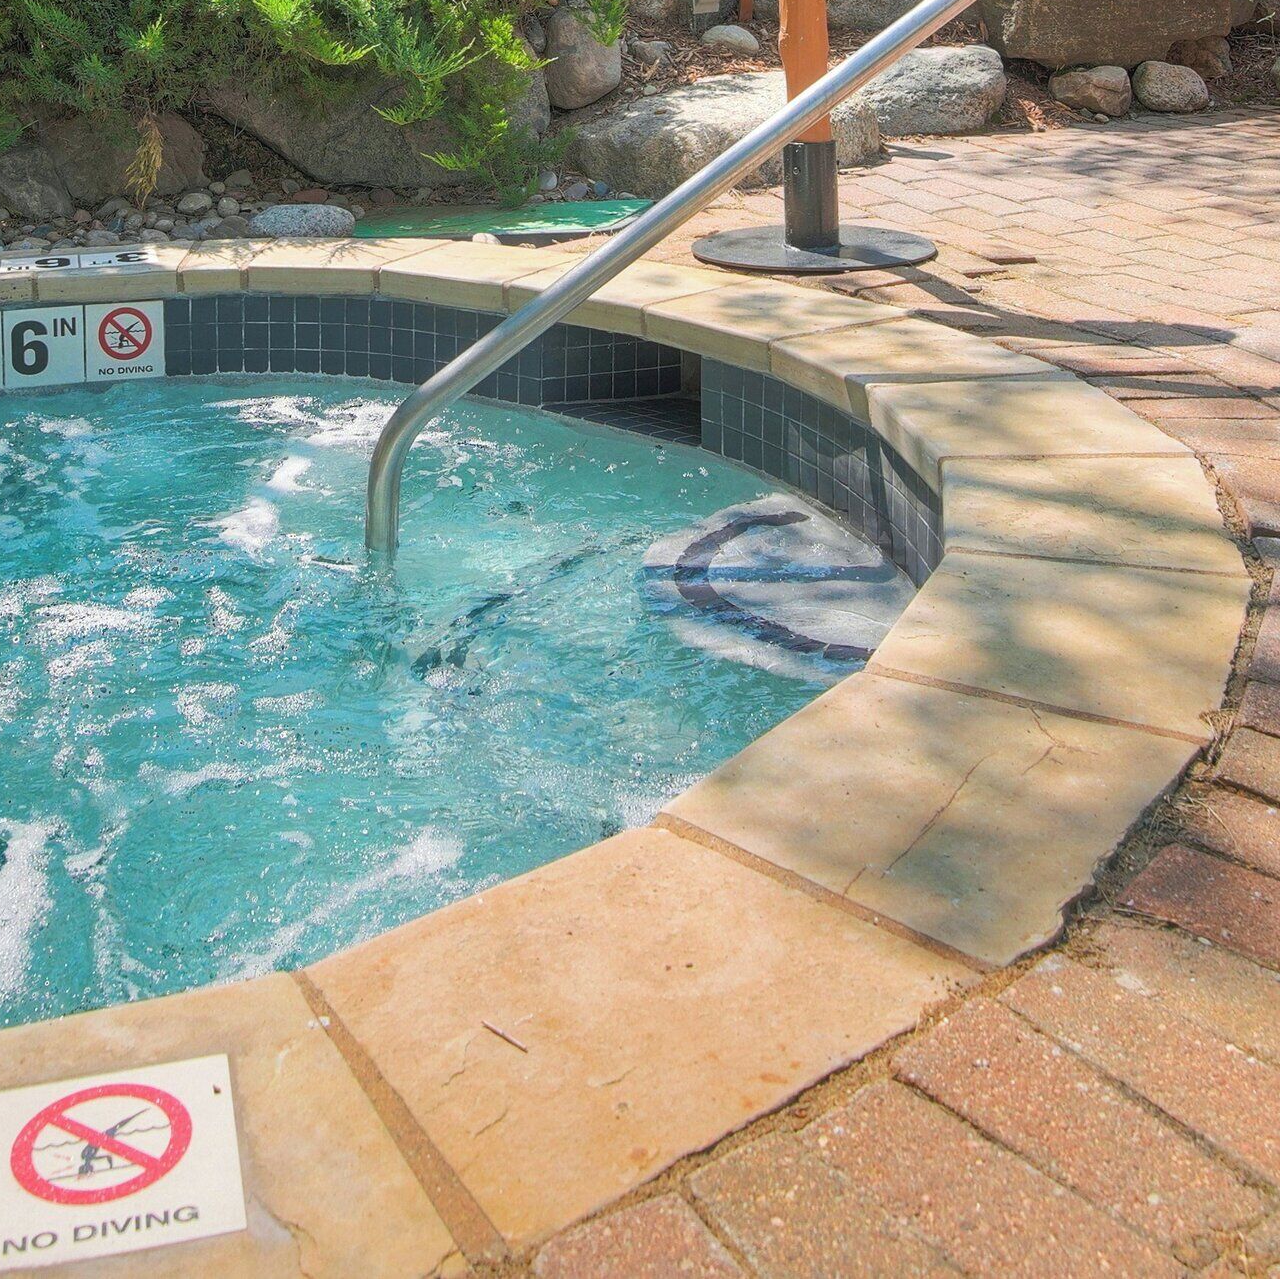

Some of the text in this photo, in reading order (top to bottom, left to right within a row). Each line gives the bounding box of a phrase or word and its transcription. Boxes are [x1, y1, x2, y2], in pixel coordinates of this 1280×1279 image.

[34, 257, 71, 268] 6
[116, 251, 150, 263] 3
[11, 320, 49, 375] 6
[53, 316, 77, 337] IN
[98, 364, 154, 376] NO DIVING
[2, 1205, 200, 1255] NO DIVING
